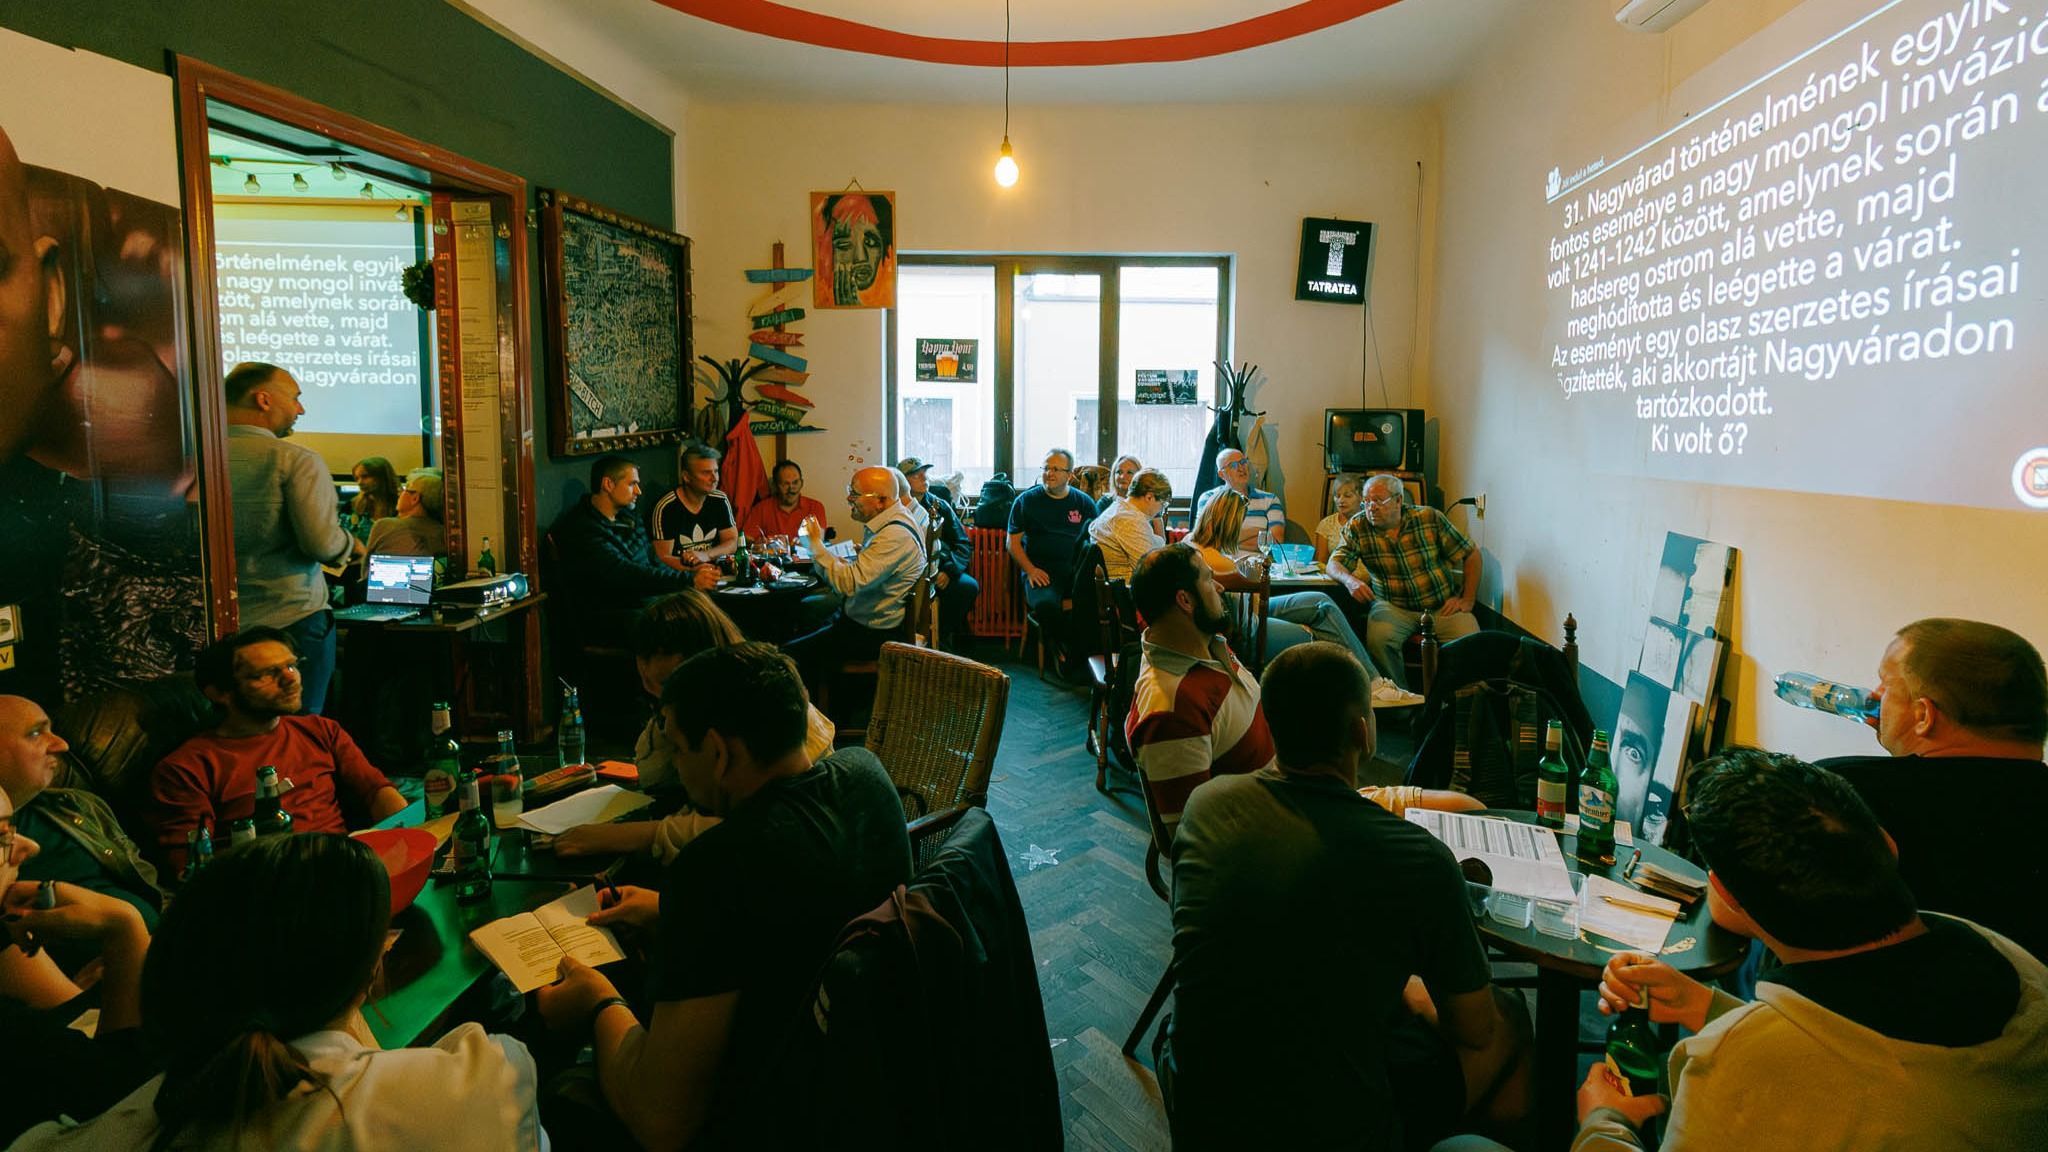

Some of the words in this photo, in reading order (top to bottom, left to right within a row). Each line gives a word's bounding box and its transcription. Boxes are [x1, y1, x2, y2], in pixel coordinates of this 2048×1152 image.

[1563, 200, 1584, 230] 31.
[1587, 146, 1676, 218] Nagyvárad
[1680, 42, 1880, 172] történelmének
[1550, 229, 1590, 263] fontos
[1592, 192, 1677, 245] eseménye
[1682, 184, 1694, 207] a
[1699, 154, 1758, 199] nagy
[1765, 80, 1888, 172] mongol
[1547, 260, 1571, 289] volt
[1574, 226, 1655, 281] 1241-1242
[1661, 202, 1731, 249] között,
[1738, 135, 1884, 221] amelynek
[1894, 91, 2018, 165] során
[1571, 270, 1640, 309] hadsereg
[1645, 247, 1714, 287] ostrom
[1720, 225, 1756, 266] alá
[1763, 208, 1844, 252] vette,
[1856, 152, 1957, 226] majd
[216, 252, 348, 272] örténelmének
[1567, 294, 1673, 340] meghódította
[1678, 282, 1702, 313] és
[1708, 257, 1817, 308] leégette
[1825, 251, 1843, 280] a
[1853, 215, 1962, 272] várat.
[226, 275, 274, 294] nagy
[279, 274, 354, 296] mongol
[1307, 280, 1358, 295] TATRATEA
[261, 291, 354, 313] amelynek
[358, 294, 412, 312] során
[1551, 344, 1568, 368] Az
[1570, 331, 1642, 365] eseményt
[1646, 327, 1681, 360] egy
[1685, 312, 1742, 348] olasz
[1748, 286, 1891, 337] szerzetes
[1902, 247, 2020, 312] írásai
[249, 309, 277, 327] alá
[281, 313, 335, 331] vette,
[341, 311, 389, 334] majd
[240, 327, 320, 350] leégette
[324, 333, 336, 347] a
[340, 331, 393, 348] várat.
[1631, 357, 1657, 389] aki
[1661, 344, 1757, 387] akkortájt
[1765, 310, 2015, 381] Nagyváradon
[222, 345, 271, 363] olasz
[275, 350, 362, 366] szerzetes
[367, 349, 417, 367] írásai
[288, 365, 417, 388] Nagyváradon
[1636, 382, 1773, 420] tartózkodott.
[1651, 423, 1669, 452] Ki
[1674, 422, 1713, 454] volt
[1718, 422, 1748, 455] ő?
